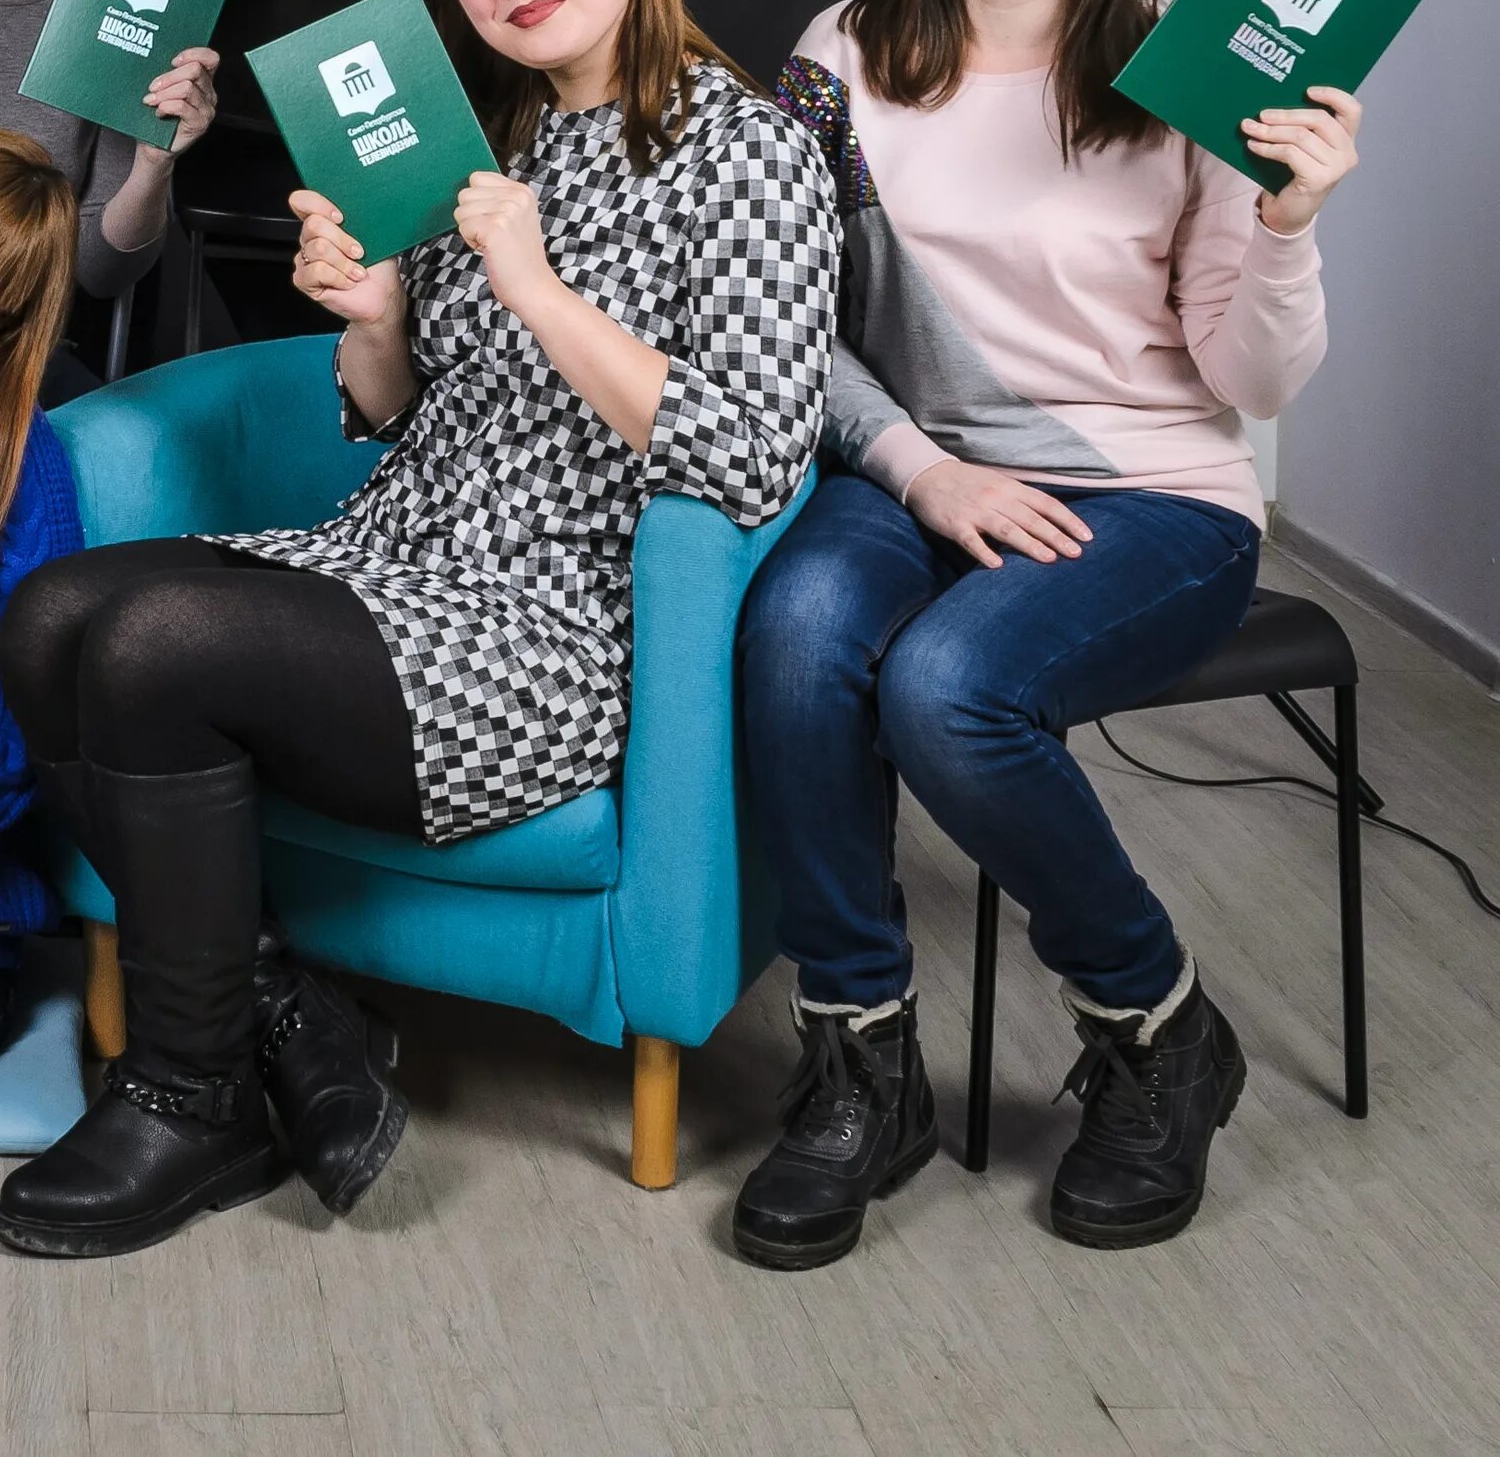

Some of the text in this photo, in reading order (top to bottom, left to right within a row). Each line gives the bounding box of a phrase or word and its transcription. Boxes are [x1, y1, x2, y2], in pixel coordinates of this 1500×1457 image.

[100, 15, 154, 49] ШКОЛА
[1233, 22, 1296, 74] ШКОЛА
[351, 117, 416, 157] ШКОЛА
